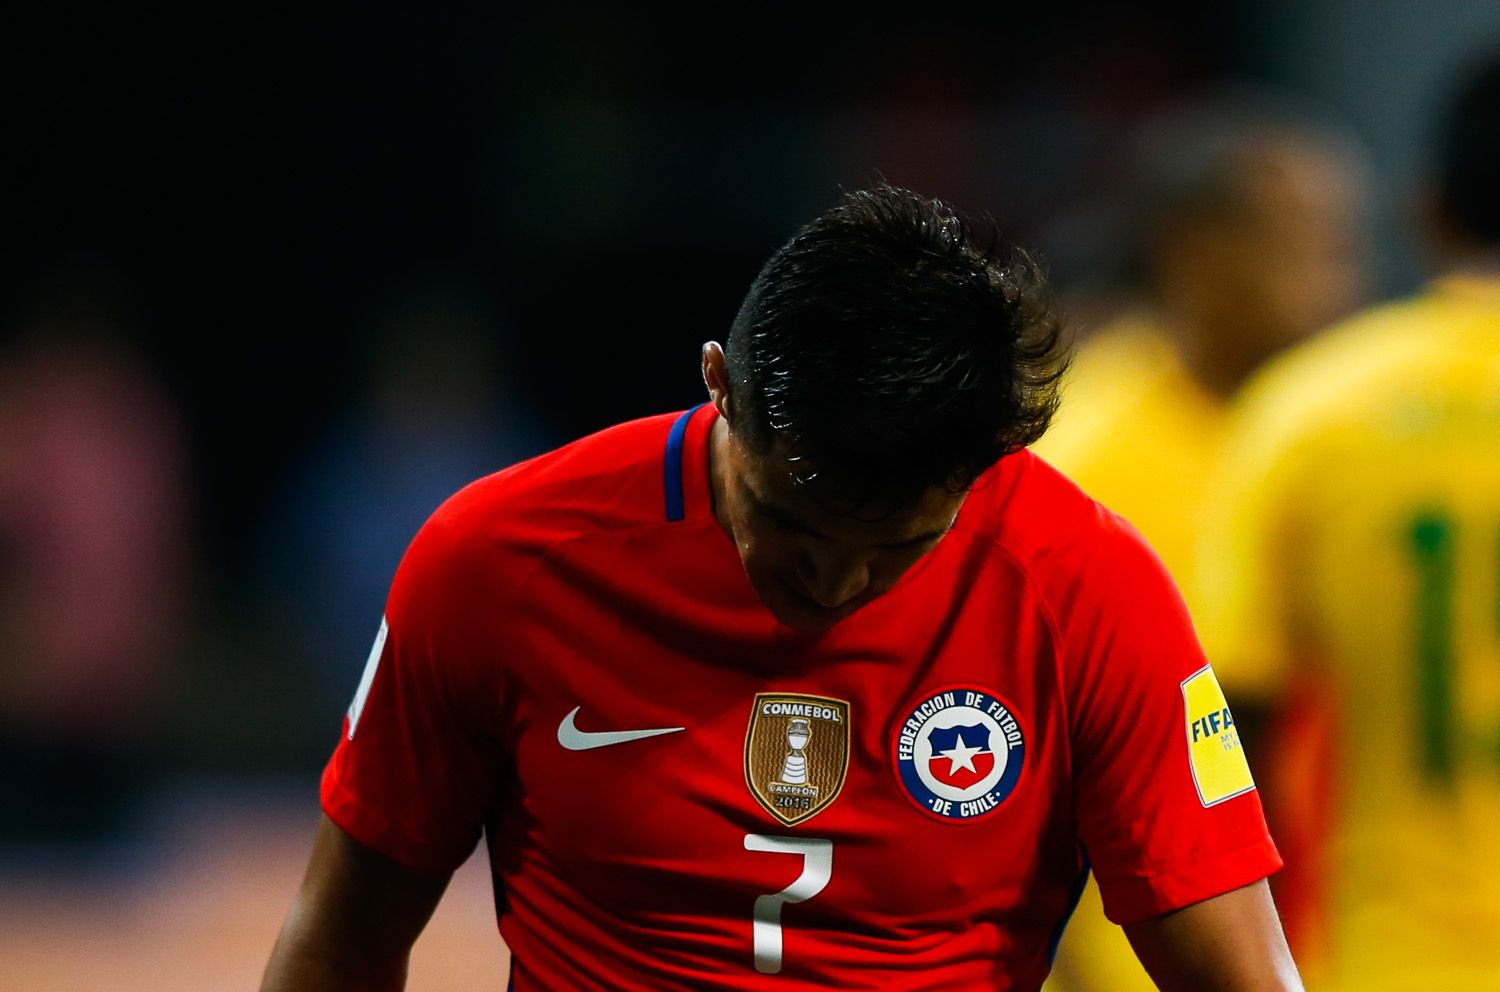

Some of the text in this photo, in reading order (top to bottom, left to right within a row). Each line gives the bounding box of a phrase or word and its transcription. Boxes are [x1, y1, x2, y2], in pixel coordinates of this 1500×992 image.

[763, 703, 839, 721] CONMEBOL
[899, 691, 1022, 761] FEDERACION DE FUTBOL
[1192, 708, 1233, 742] FIFA
[776, 797, 810, 809] 2016
[932, 792, 998, 817] DE CHILE
[744, 834, 833, 974] 7
